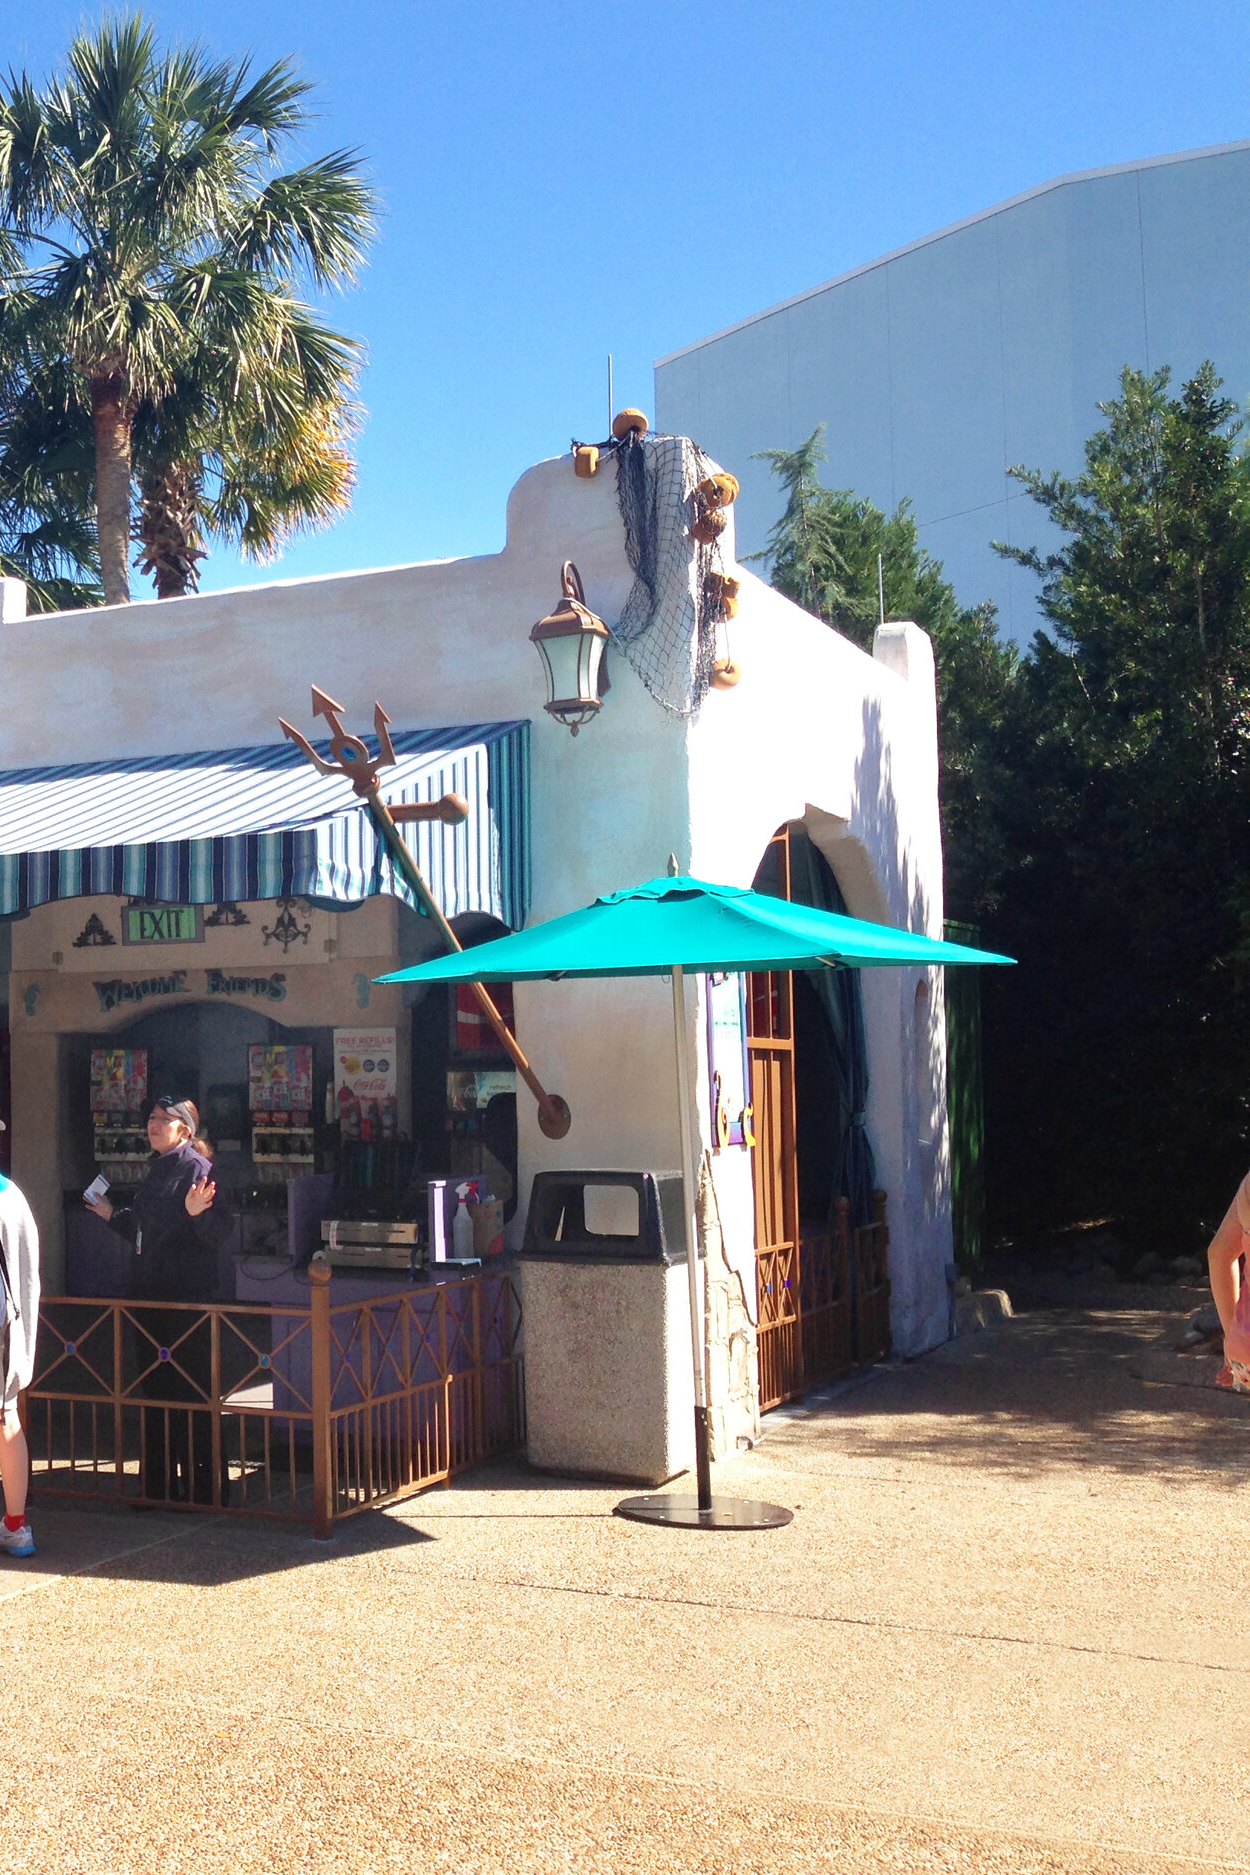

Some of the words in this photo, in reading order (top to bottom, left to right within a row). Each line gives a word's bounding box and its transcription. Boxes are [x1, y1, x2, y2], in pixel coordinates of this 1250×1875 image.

[139, 909, 184, 940] EXIT
[93, 970, 191, 1012] WELCOME
[205, 968, 287, 1002] FRIENDS
